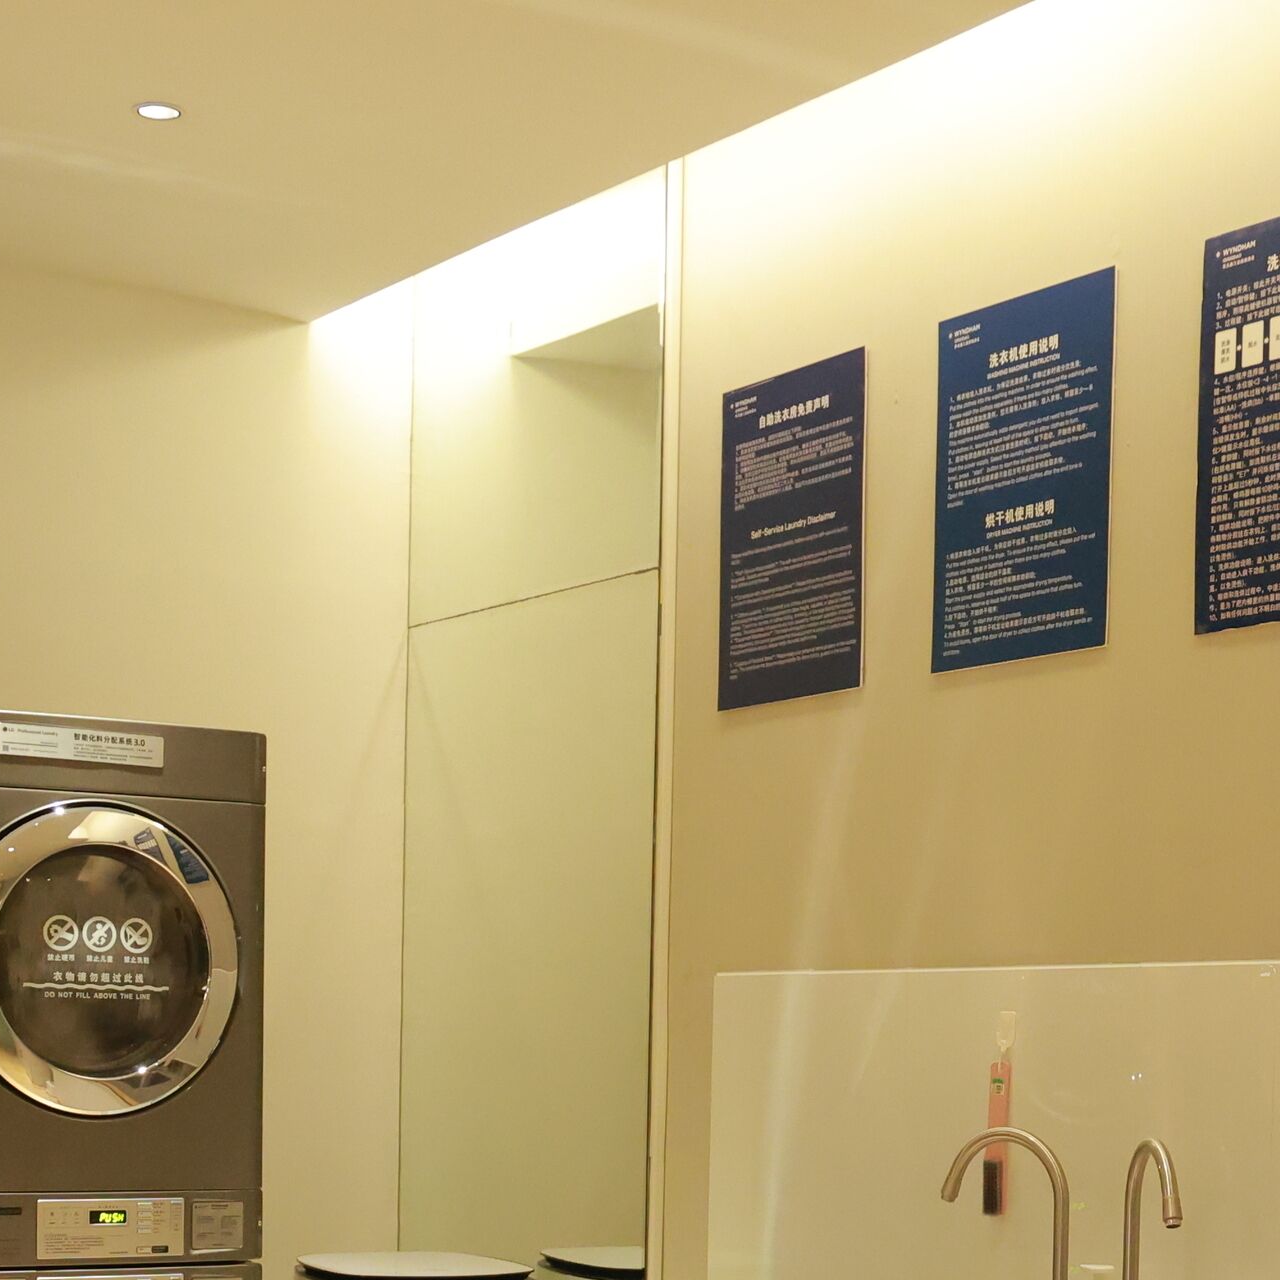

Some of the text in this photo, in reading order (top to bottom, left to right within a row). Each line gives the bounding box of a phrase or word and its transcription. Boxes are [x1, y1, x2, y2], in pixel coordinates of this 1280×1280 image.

[989, 333, 1058, 368] 洗衣机使用说明
[1008, 361, 1028, 373] MACHINE
[1029, 353, 1060, 367] INSTRUCTION
[759, 394, 829, 429] 自助洗衣房免责声明
[751, 511, 836, 539] Self-Service Laundry Disclaimer
[985, 498, 1054, 528] 烘干机使用说明
[986, 519, 1052, 539] DRYER MACHINE INSTRUCTION
[50, 971, 143, 987] 衣物请勿超过此线
[99, 1213, 124, 1223] PUSH
